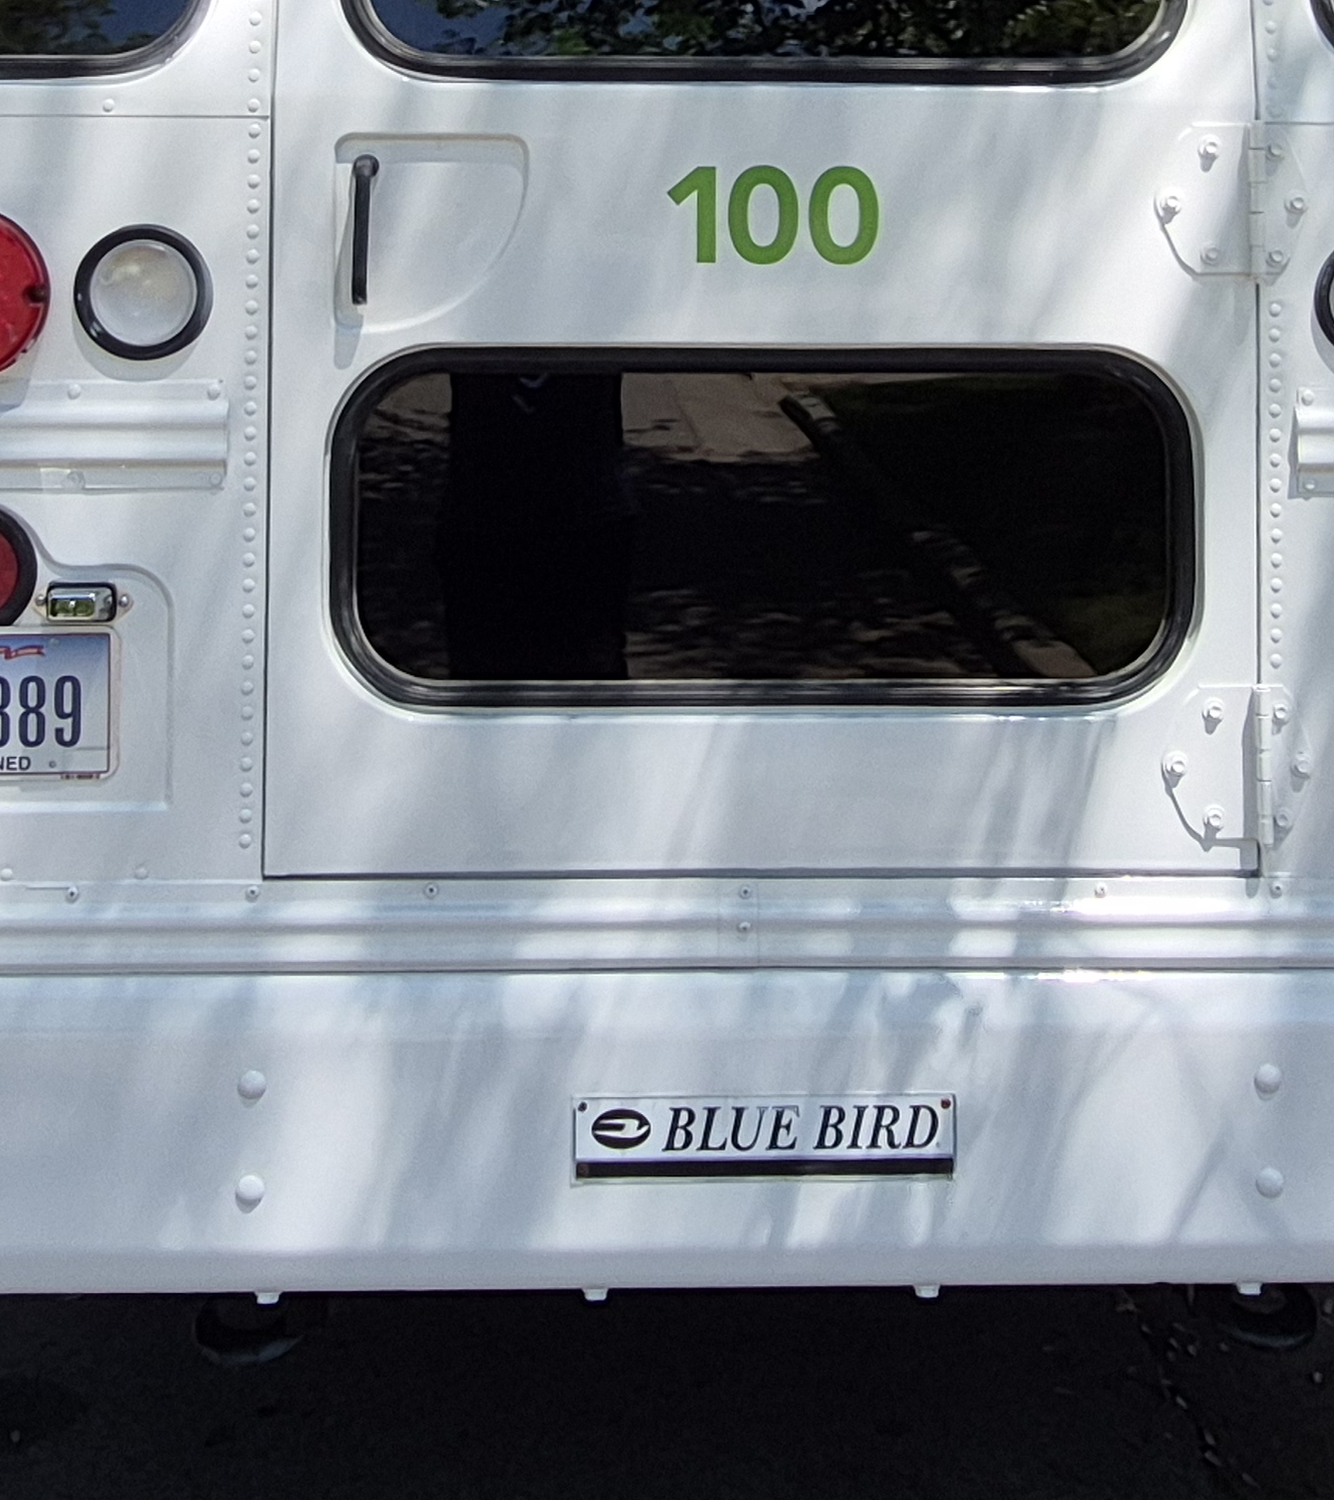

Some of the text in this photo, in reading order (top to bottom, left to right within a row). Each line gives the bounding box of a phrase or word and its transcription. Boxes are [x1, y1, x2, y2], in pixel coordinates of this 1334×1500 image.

[667, 164, 879, 265] 100
[661, 1103, 940, 1153] BLUE BIRD
